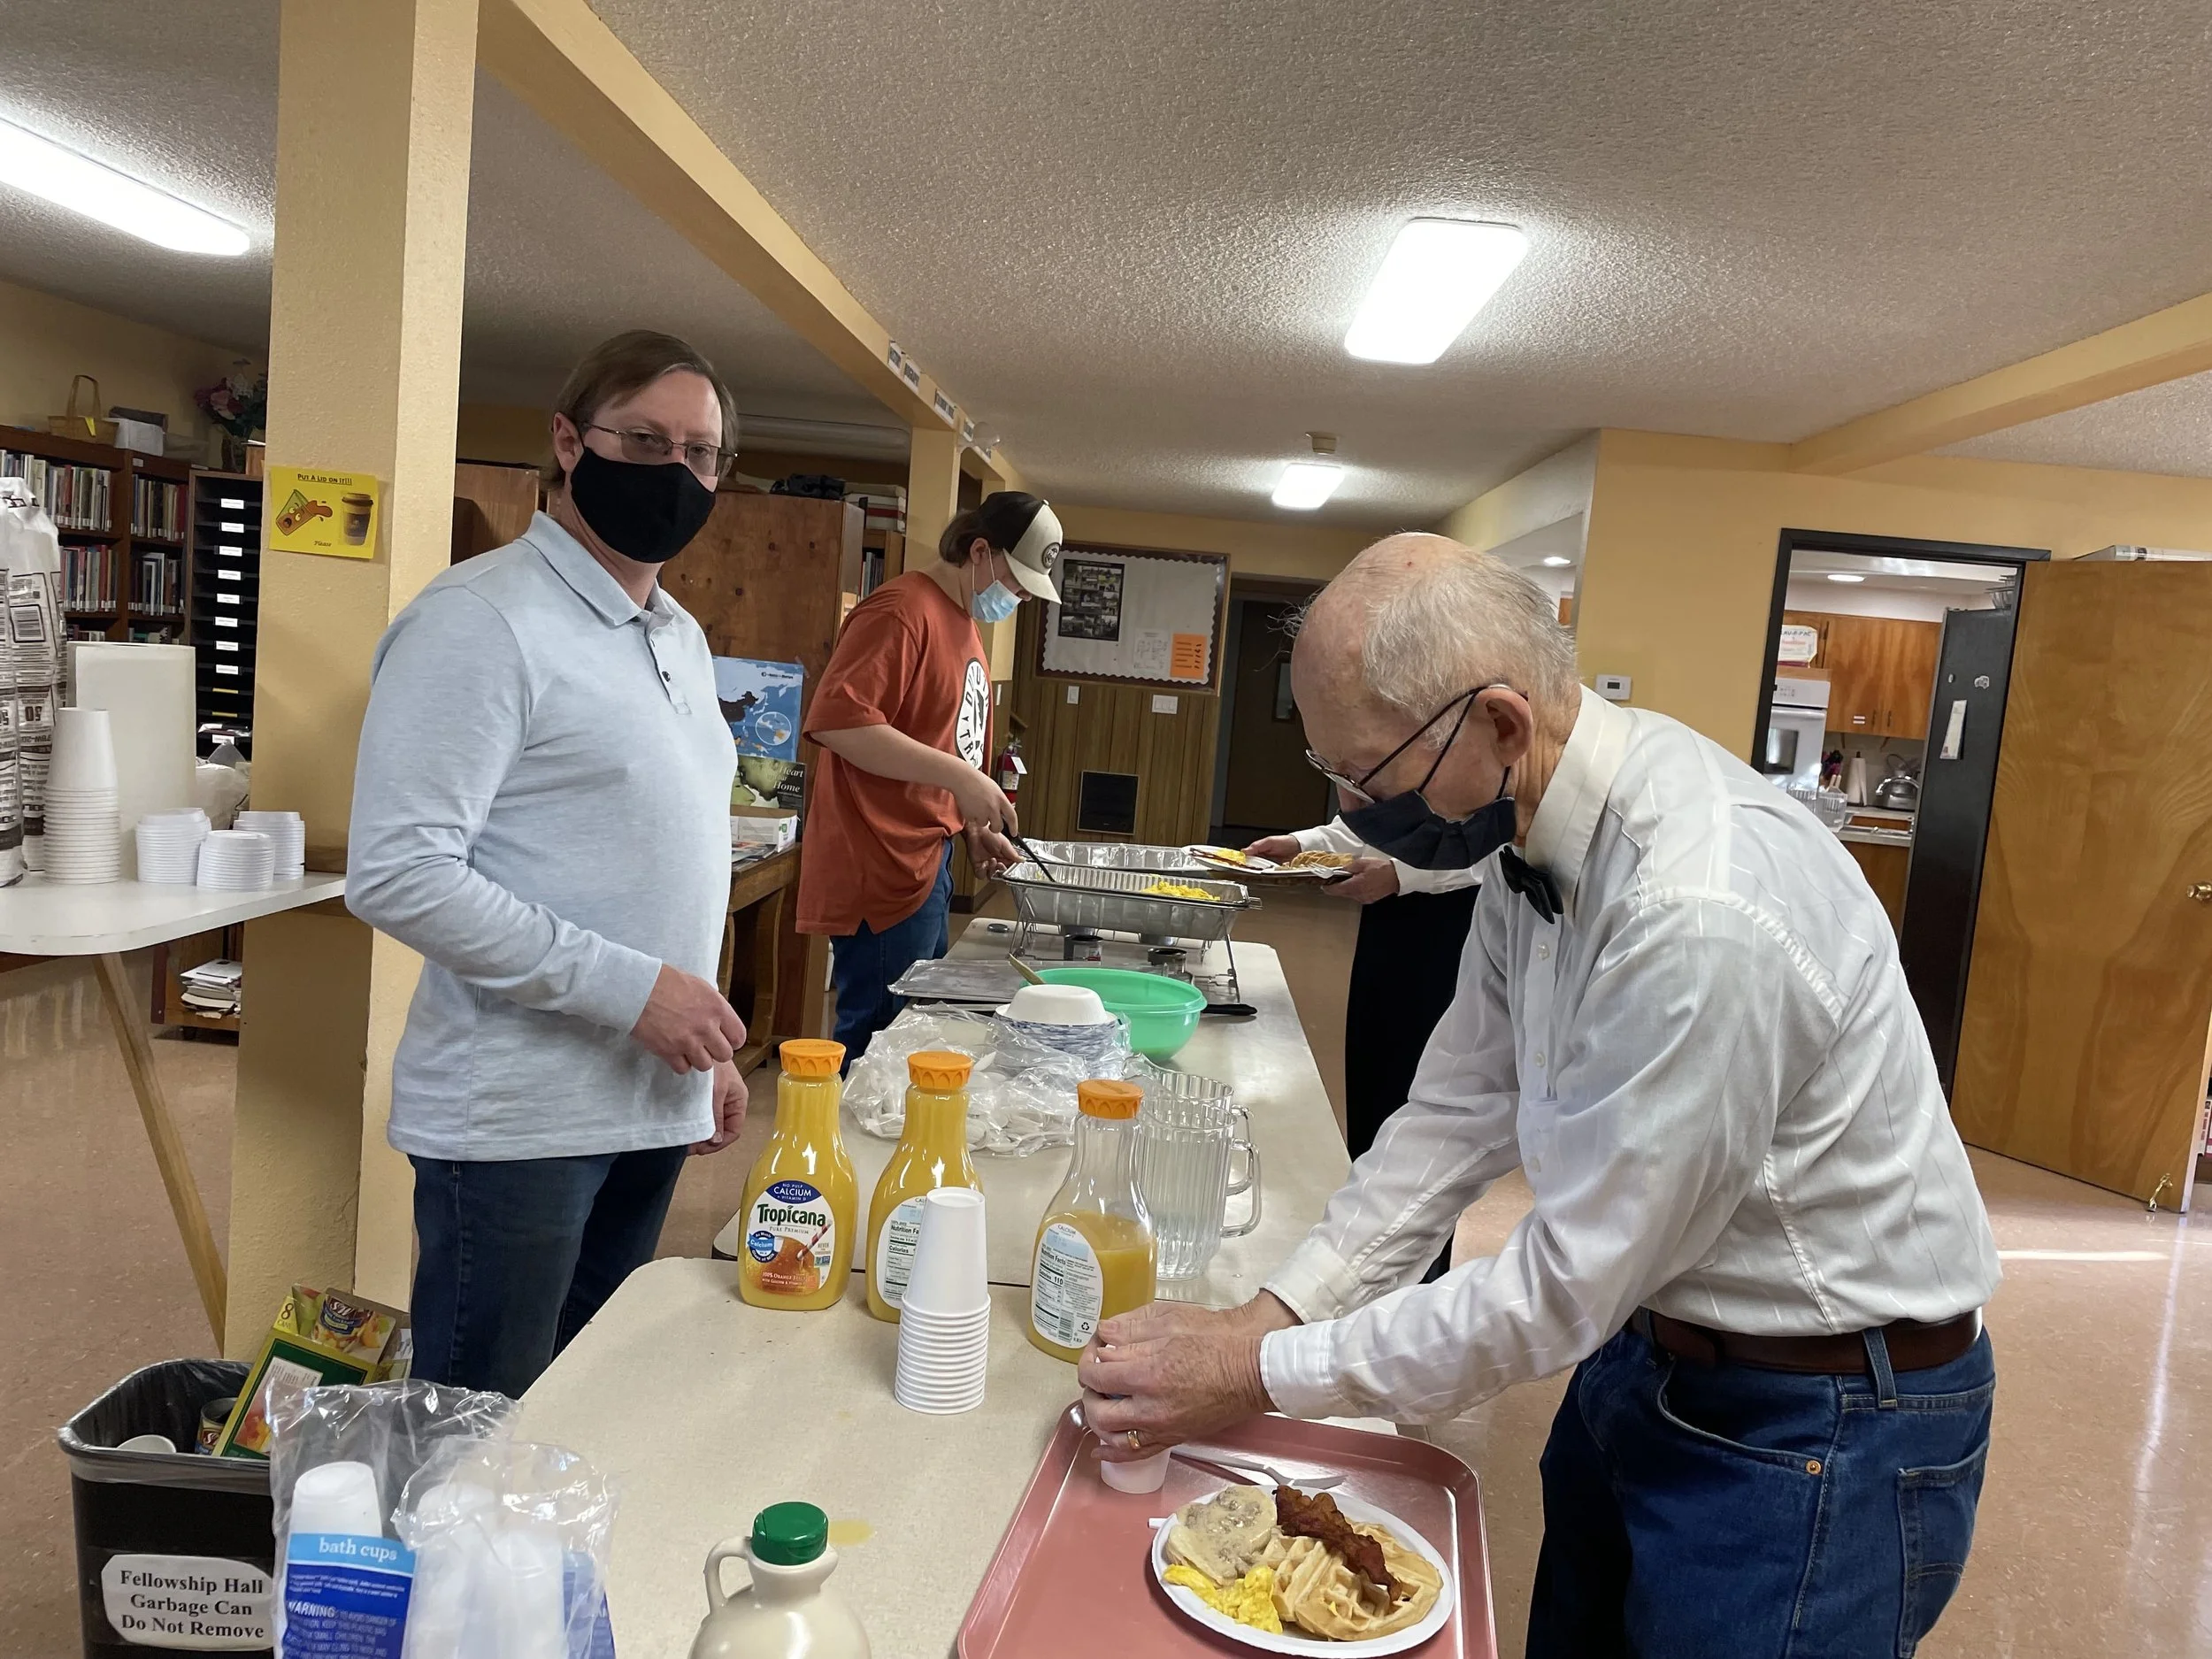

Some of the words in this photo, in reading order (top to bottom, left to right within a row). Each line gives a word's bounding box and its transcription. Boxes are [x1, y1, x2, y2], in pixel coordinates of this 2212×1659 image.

[780, 766, 803, 778] Heart
[773, 780, 801, 793] Home
[773, 1187, 811, 1197] CALCIUM
[757, 1204, 826, 1226] Tropicana
[891, 1225, 911, 1233] Nutrition
[1057, 1225, 1076, 1234] CALCIUM
[750, 1239, 773, 1248] Calcium
[888, 1245, 909, 1254] Calories
[1055, 1255, 1066, 1265] Facts
[1054, 1275, 1064, 1285] 110
[281, 1302, 295, 1320] 8
[319, 1537, 357, 1555] bath
[360, 1545, 398, 1563] cups
[120, 1570, 218, 1595] Fellowship
[224, 1578, 264, 1594] Hall
[130, 1594, 209, 1617] Garbage
[214, 1600, 253, 1615] Can
[121, 1614, 147, 1631] Do
[152, 1617, 184, 1634] Not
[189, 1621, 265, 1638] Remove
